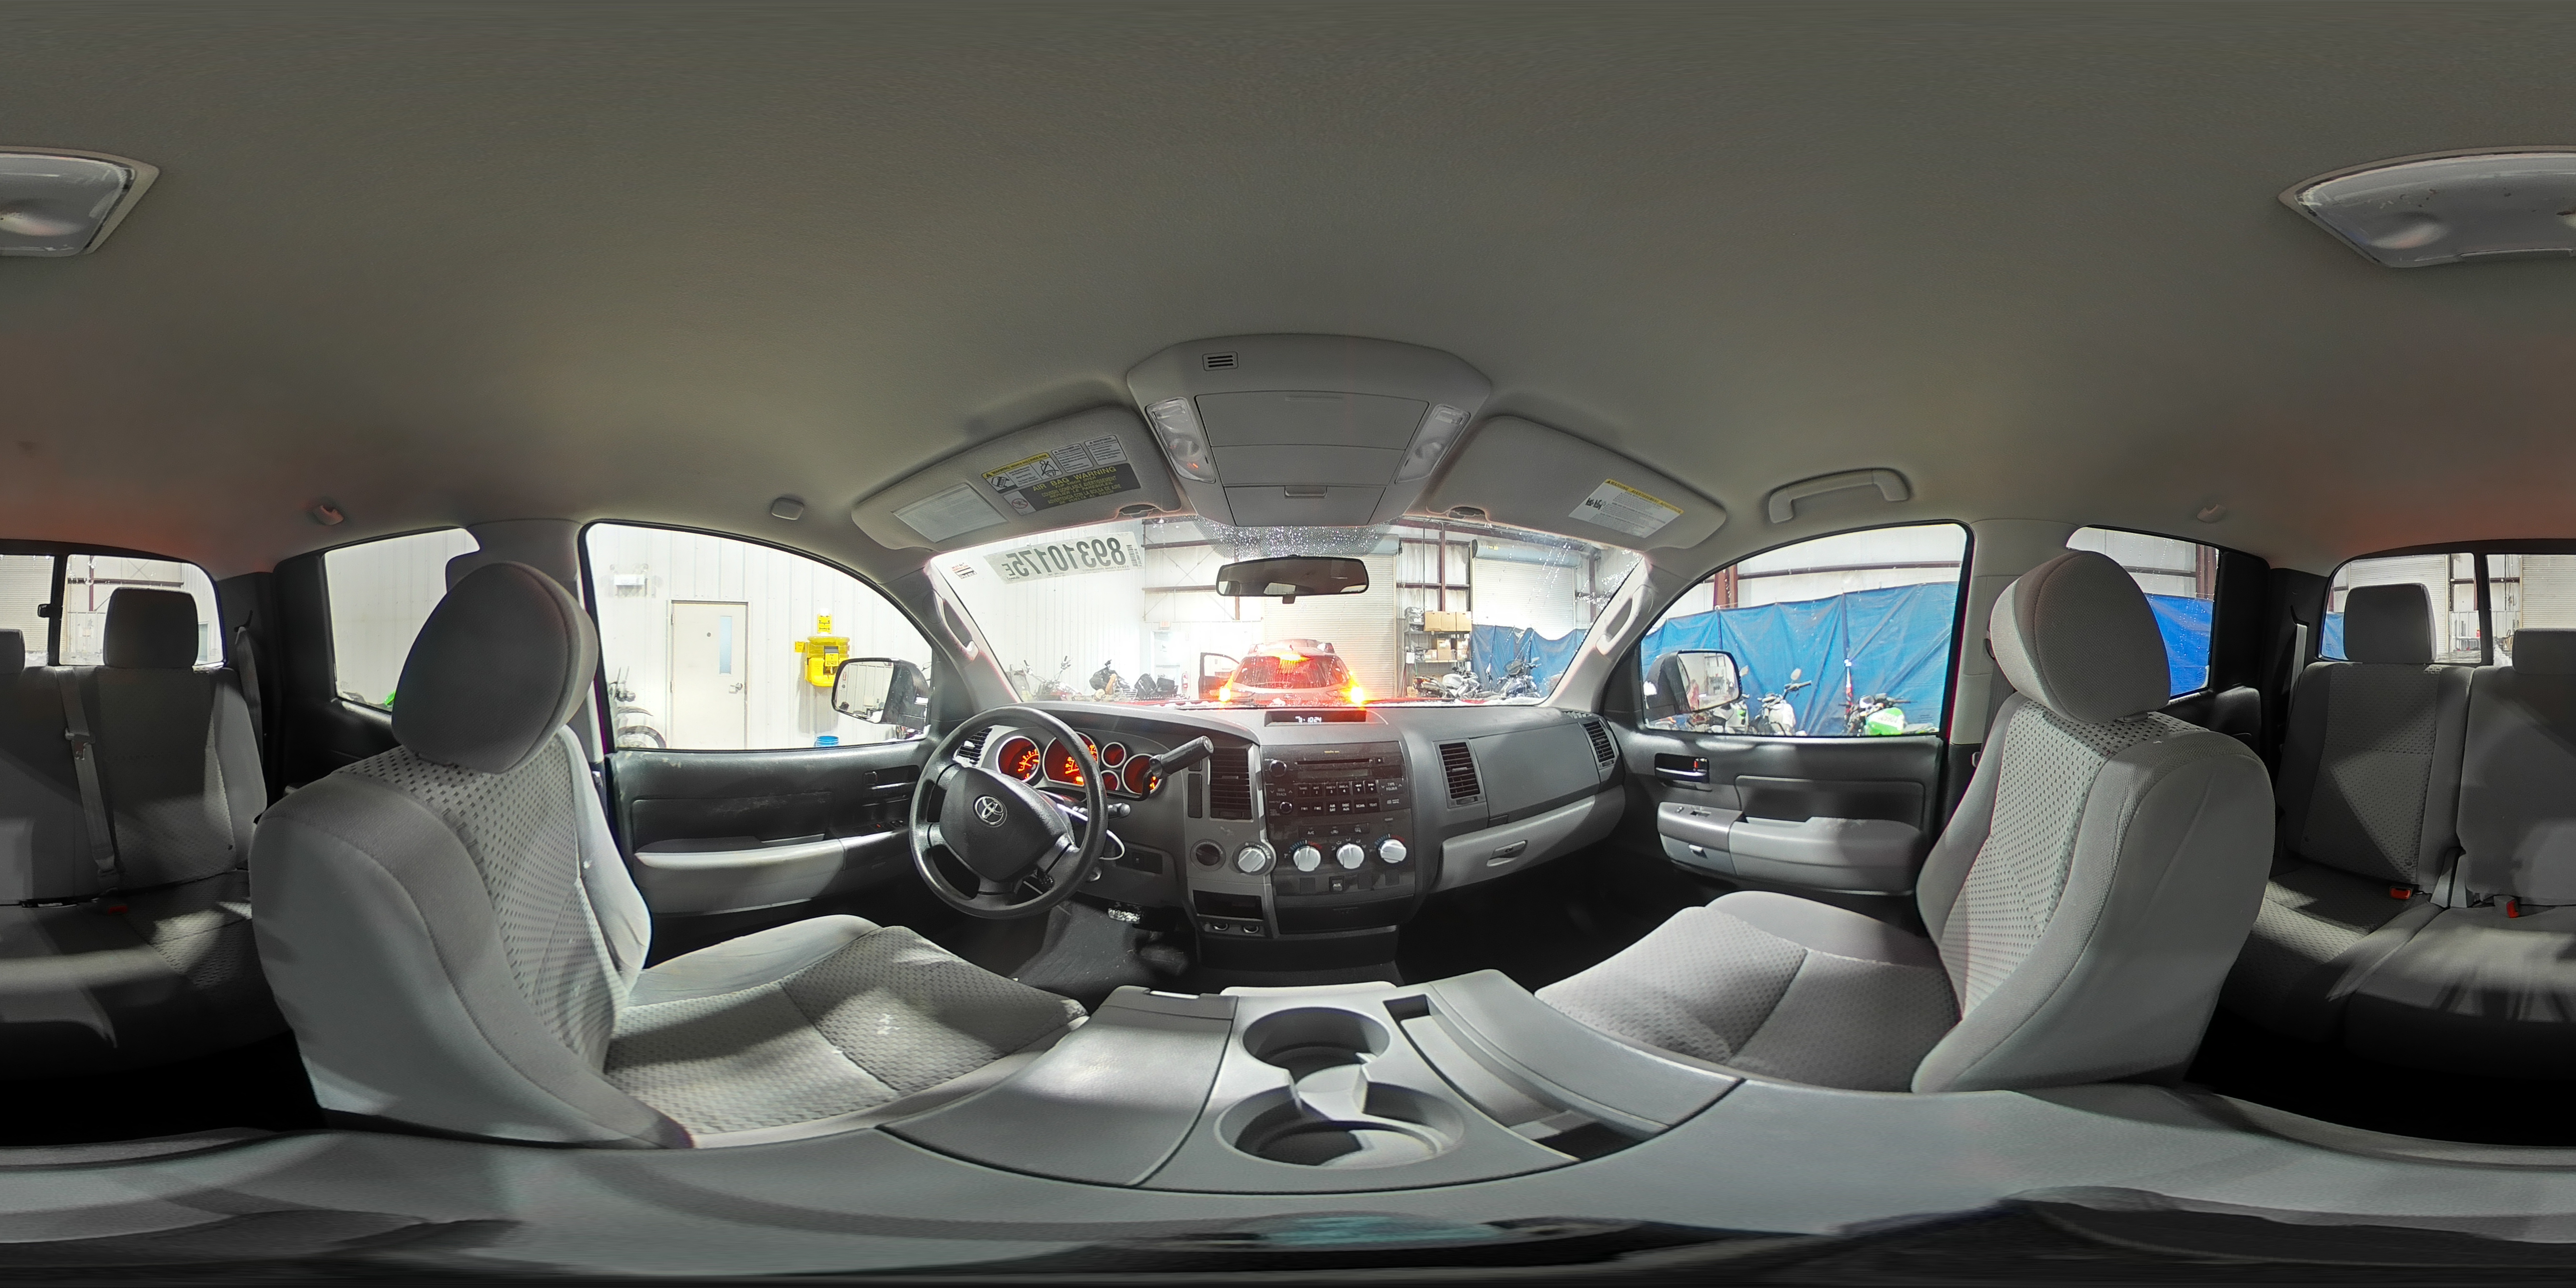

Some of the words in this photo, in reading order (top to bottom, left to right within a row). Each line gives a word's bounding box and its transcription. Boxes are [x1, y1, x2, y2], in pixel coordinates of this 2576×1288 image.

[1050, 478, 1070, 486] BAG
[1073, 466, 1116, 480] WARNING
[1083, 476, 1116, 487] AVERTISSEMENT
